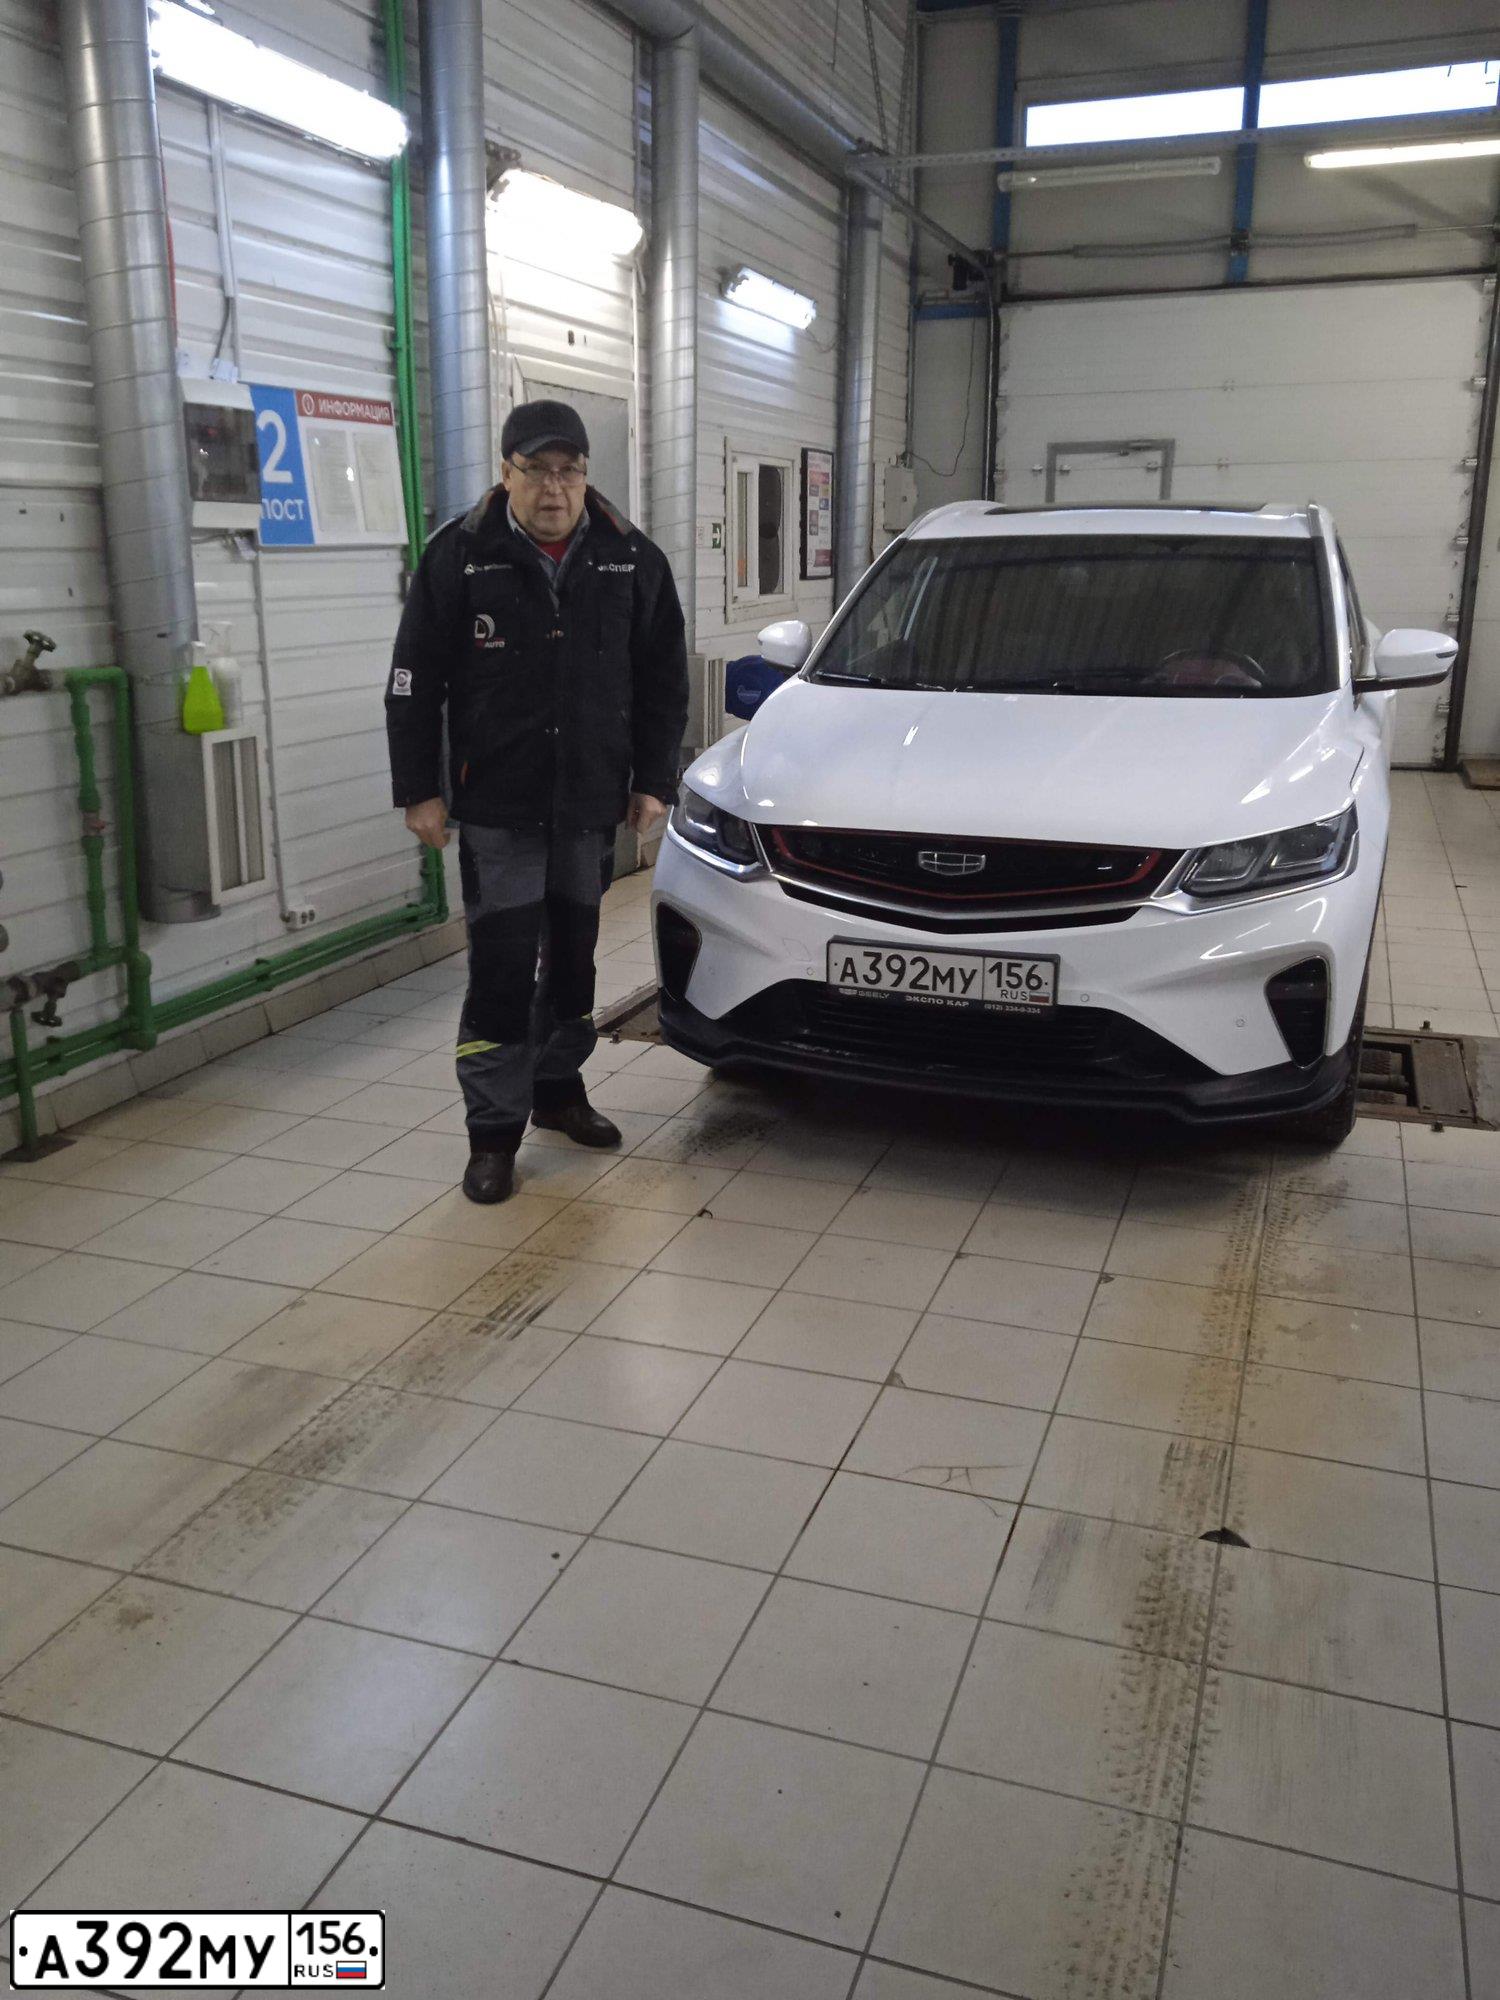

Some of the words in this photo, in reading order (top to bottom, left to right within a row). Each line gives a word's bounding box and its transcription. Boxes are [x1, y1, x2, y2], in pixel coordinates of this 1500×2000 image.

[318, 399, 391, 422] ИНФОРМАЦИЯ
[256, 409, 293, 484] 2
[839, 951, 978, 994] А392МУ
[988, 962, 1043, 991] 156
[858, 990, 890, 999] GEELY
[905, 995, 944, 1006] ЭКСПО
[946, 999, 970, 1007] КАР
[1000, 989, 1028, 1001] RUS
